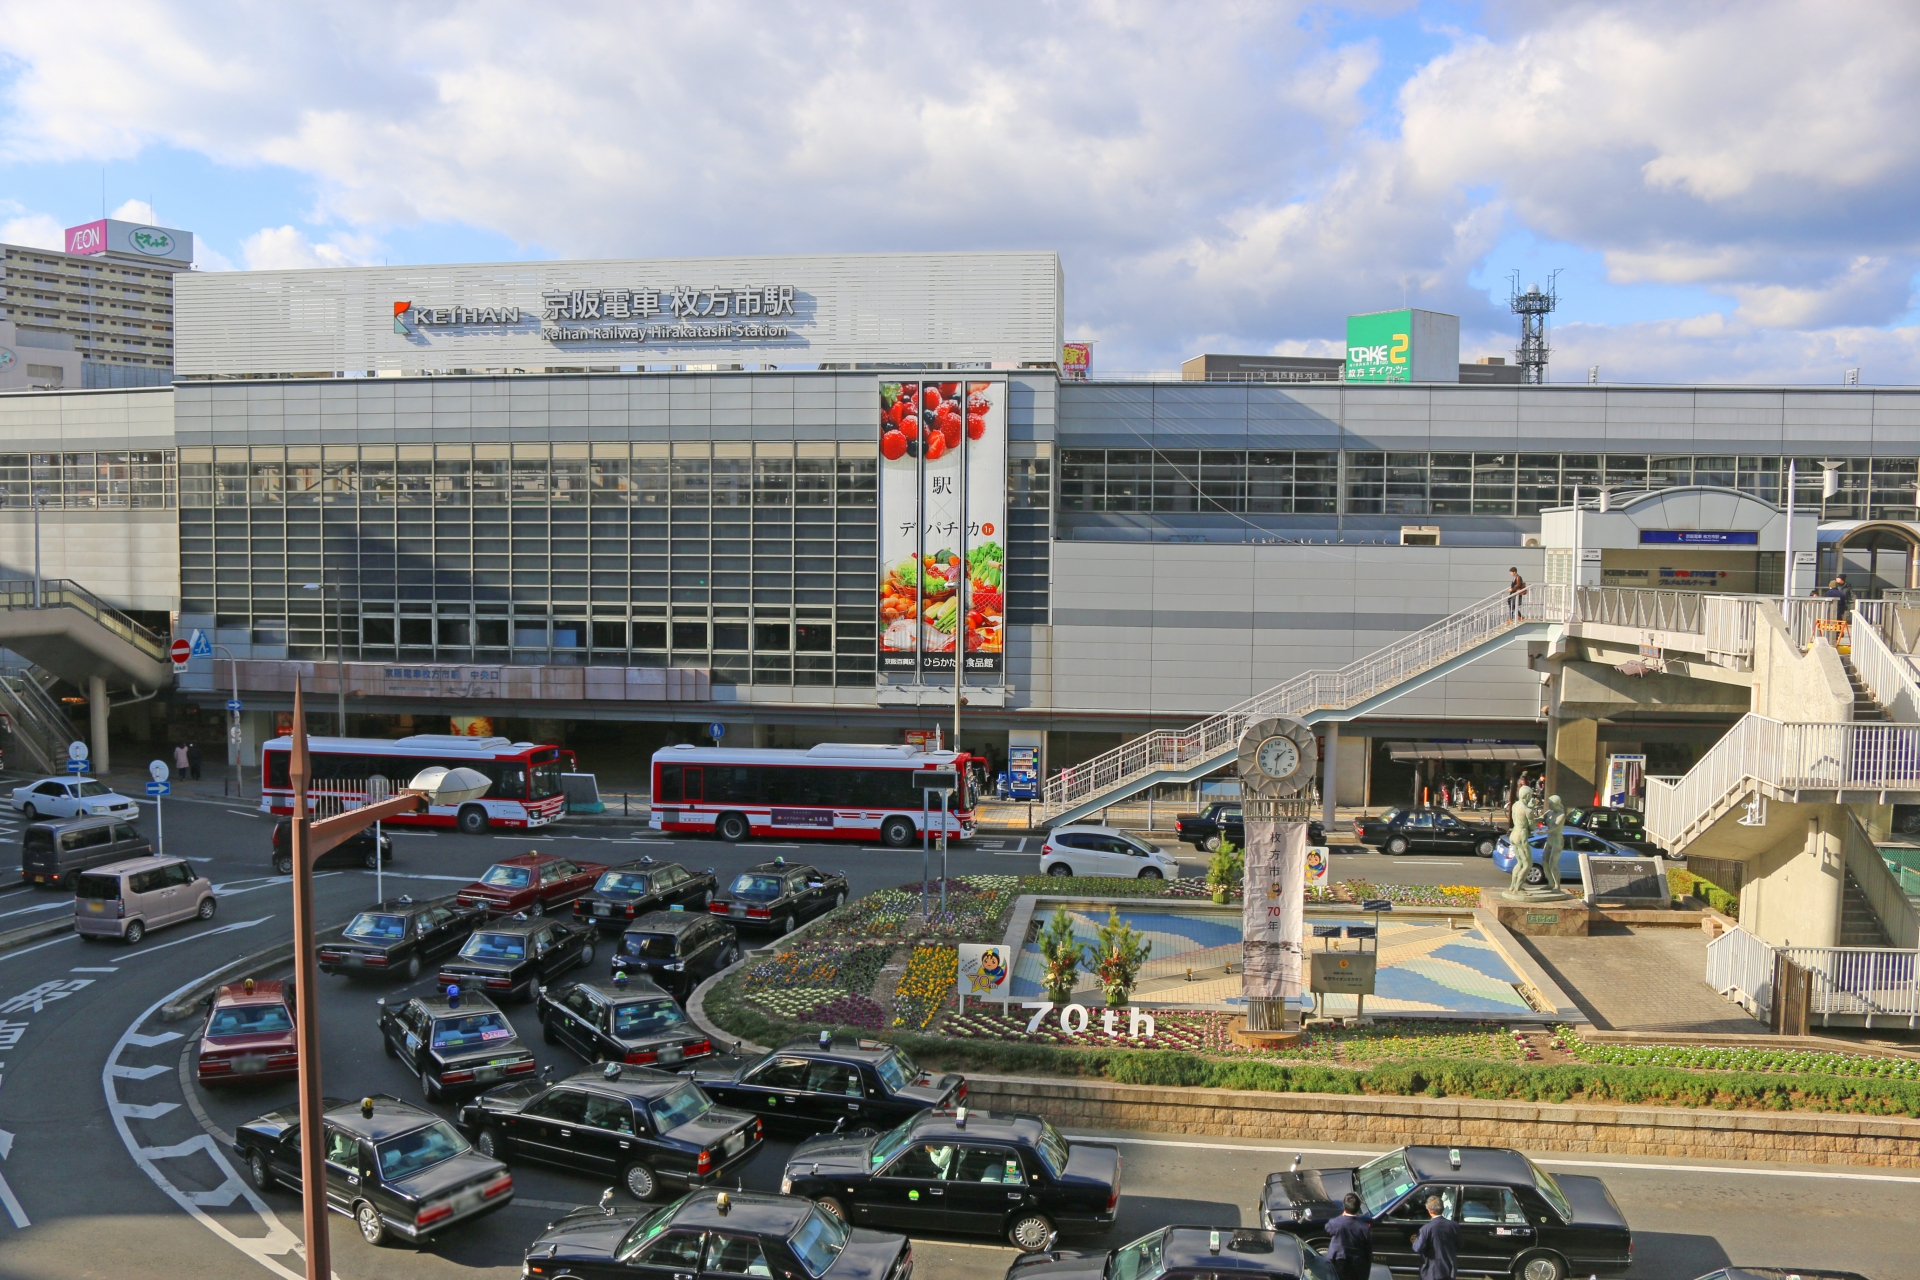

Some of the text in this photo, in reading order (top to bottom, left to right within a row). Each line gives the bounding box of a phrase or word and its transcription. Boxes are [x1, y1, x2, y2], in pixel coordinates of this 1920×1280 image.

[541, 284, 794, 320] 京阪電車 枚方市駅
[413, 306, 520, 325] KEIHAN
[541, 325, 787, 342] Keihan Railway Hirakatashi Station
[1349, 334, 1408, 365] TAKE 2
[1348, 368, 1365, 377] 枚方
[932, 476, 952, 494] 駅
[900, 521, 979, 537] デパチカ
[966, 658, 993, 668] 食品館
[470, 670, 500, 680] 中央口
[1269, 832, 1282, 878] 枚方市
[1022, 1002, 1155, 1039] 70th
